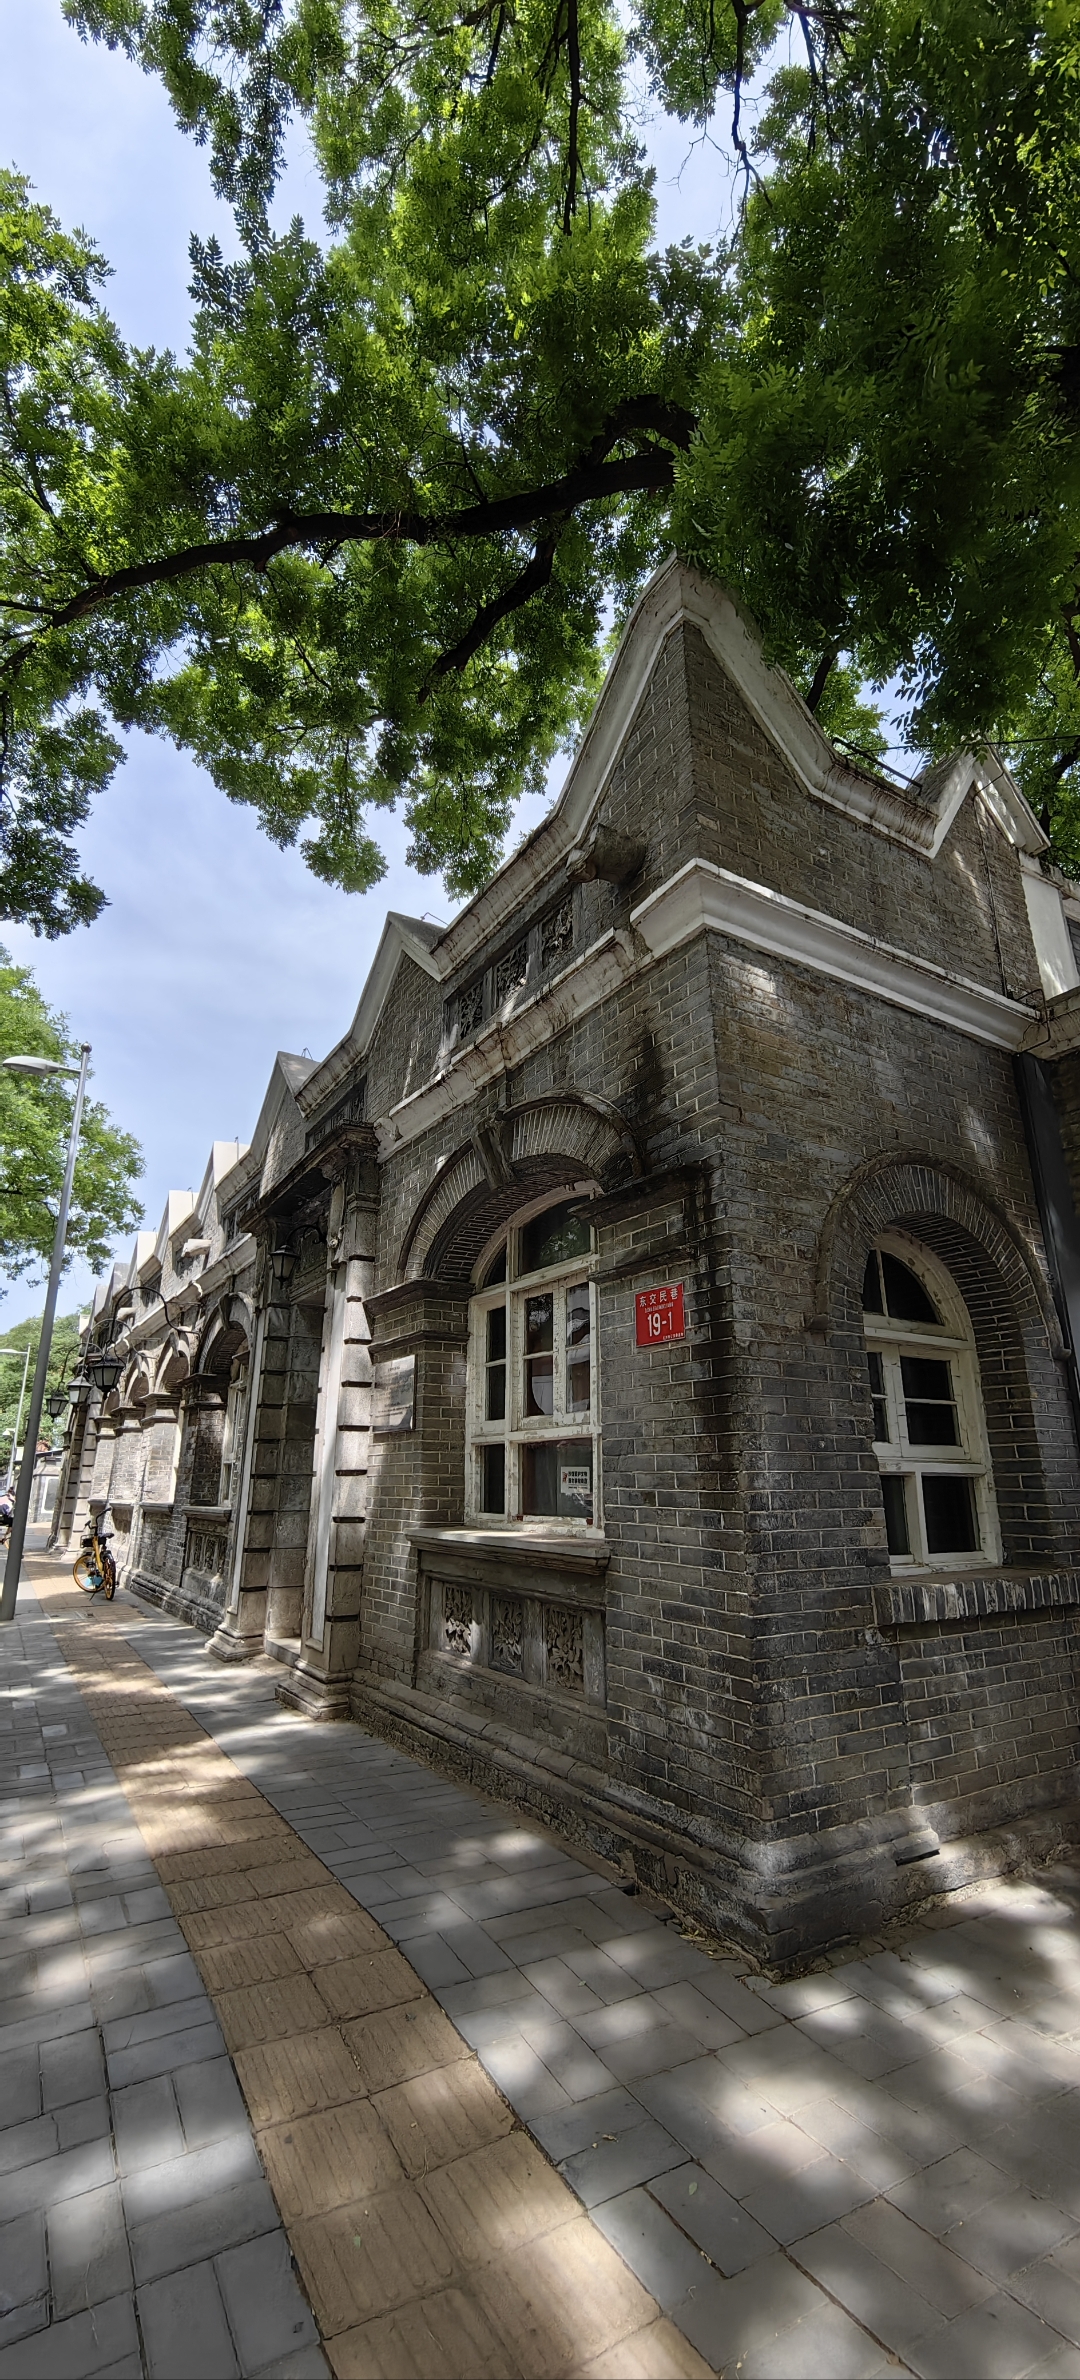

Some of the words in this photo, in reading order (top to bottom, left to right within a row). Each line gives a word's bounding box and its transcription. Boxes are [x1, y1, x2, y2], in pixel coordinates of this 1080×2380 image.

[639, 1288, 678, 1307] 东交民巷
[647, 1311, 672, 1337] 19-1
